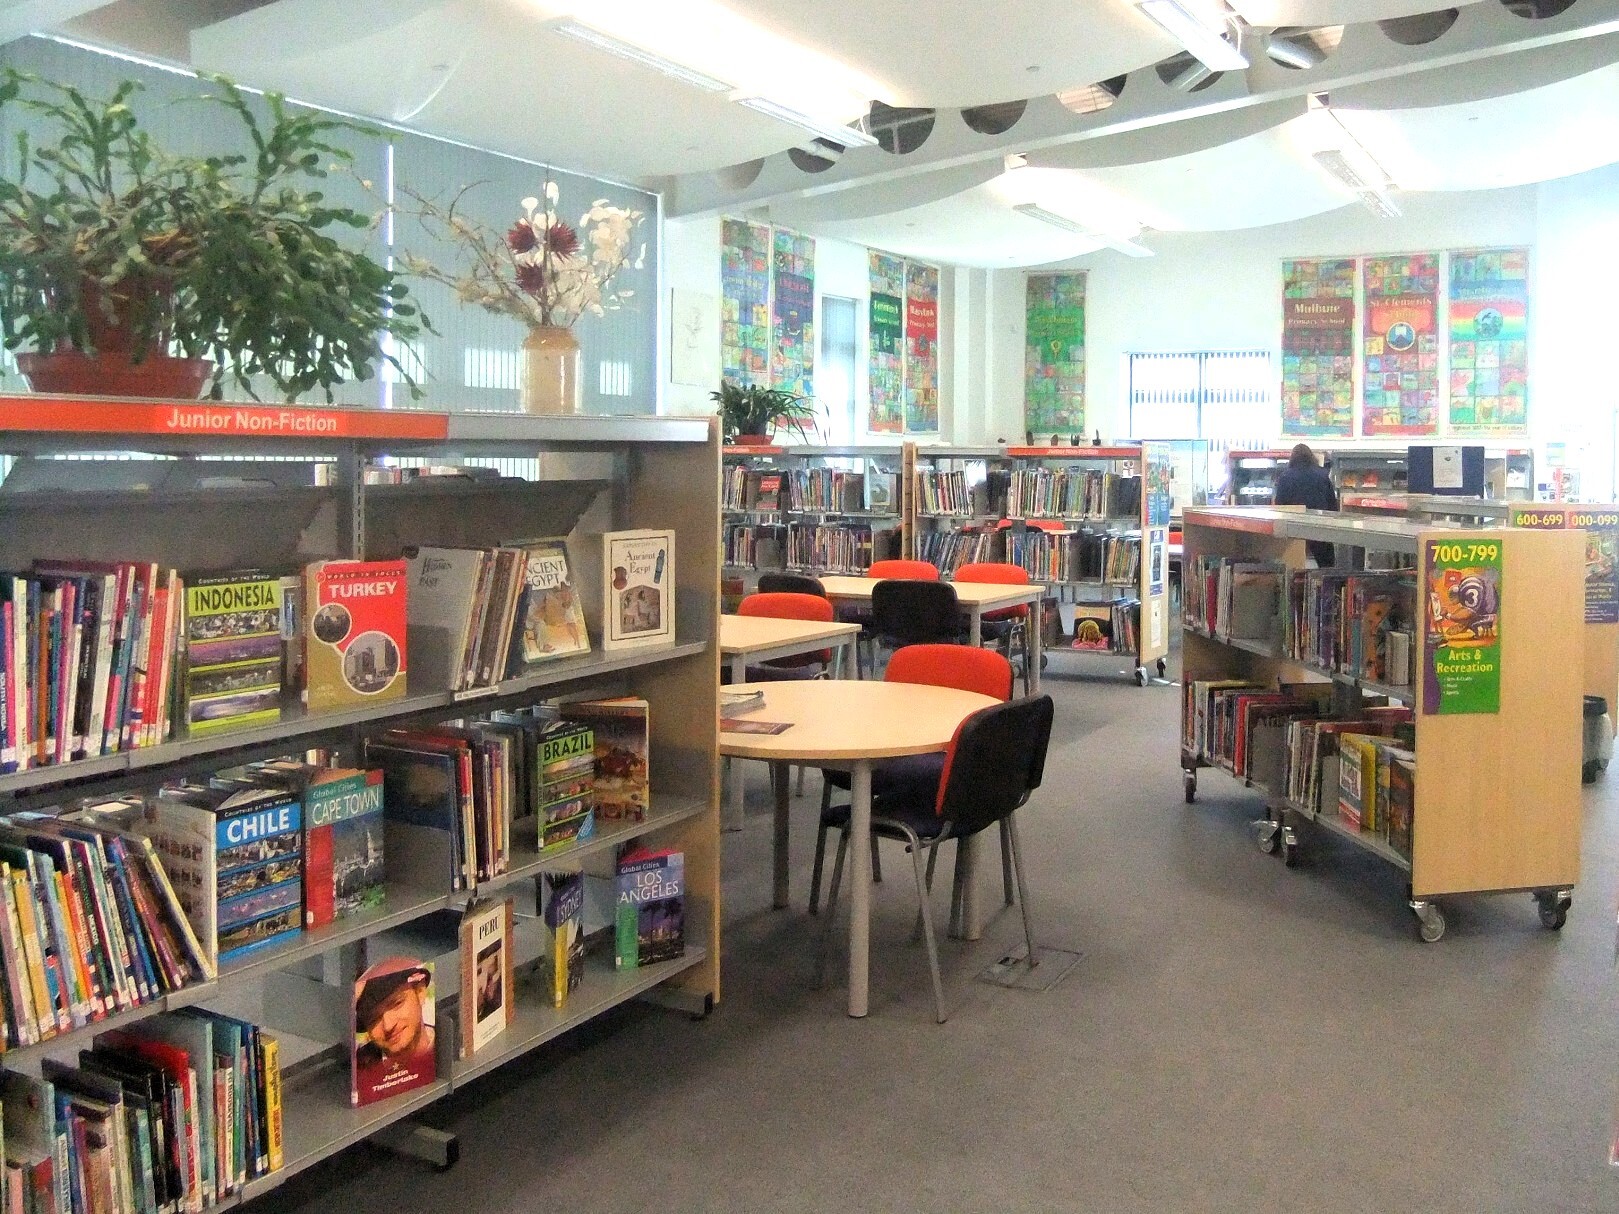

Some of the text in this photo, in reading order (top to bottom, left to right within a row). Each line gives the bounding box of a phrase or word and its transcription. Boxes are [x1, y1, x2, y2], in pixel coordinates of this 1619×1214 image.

[167, 408, 337, 431] Junior Non-Fiction
[1516, 514, 1563, 526] 600-699
[1571, 515, 1618, 526] 000-099
[624, 551, 656, 561] Ancient
[1431, 545, 1498, 562] 700-799
[630, 561, 651, 575] Egypt
[194, 584, 275, 612] INDONESIA
[328, 581, 398, 599] TURKEY
[1448, 649, 1482, 660] Arts &
[1437, 661, 1493, 673] Recreation
[543, 733, 592, 762] BRAZIL
[313, 782, 357, 799] Global Cities
[312, 787, 379, 825] CAPE TOWN
[227, 807, 290, 843] CHILE
[621, 861, 660, 874] Global Cities
[637, 869, 663, 888] LOS
[620, 880, 679, 904] ANGELES
[479, 915, 500, 940] PERU
[372, 1073, 419, 1092] Timberlake
[382, 1069, 409, 1082] Justin
